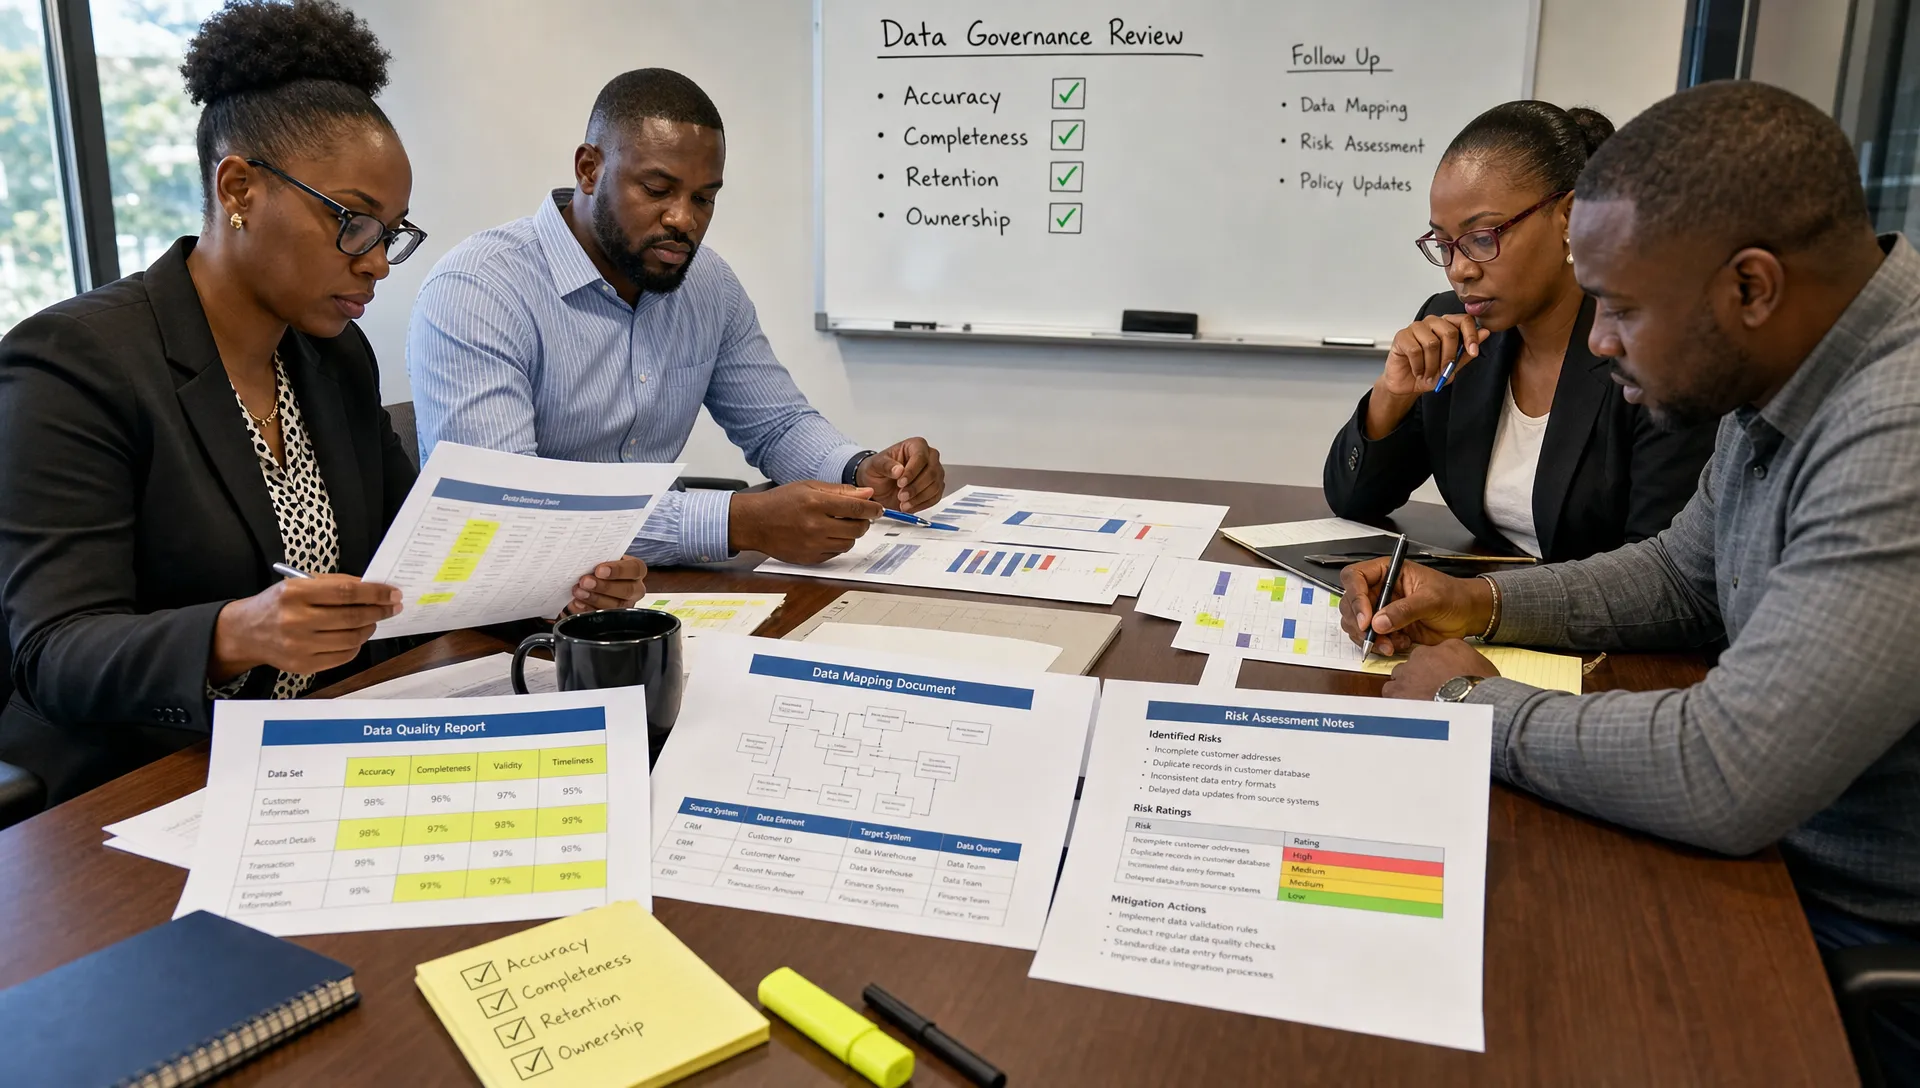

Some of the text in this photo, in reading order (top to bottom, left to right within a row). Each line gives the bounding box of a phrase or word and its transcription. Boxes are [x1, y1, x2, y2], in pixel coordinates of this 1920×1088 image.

[882, 19, 1184, 49] Data Governance Review
[1292, 44, 1381, 72] Follow Up
[904, 86, 1002, 113] Accuracy
[1301, 97, 1408, 121] Data Mapping
[904, 127, 1029, 153] Completeness
[1300, 135, 1426, 154] Risk Assessment
[906, 168, 999, 188] Retention
[1300, 174, 1412, 197] Policy Updates
[906, 208, 1011, 235] Ownership
[813, 667, 956, 696] Data Mapping Document
[1225, 711, 1355, 729] Risk Assessment Notes
[363, 721, 486, 738] Data Quality Report
[1149, 730, 1222, 743] Identified Risks
[1155, 746, 1281, 762] Incomplete customer addresses
[358, 757, 594, 776] Accuracy Completeness Validity Timeliness
[1153, 759, 1190, 769] Duplicate
[1192, 763, 1222, 771] records
[1234, 767, 1272, 775] customer
[1274, 769, 1310, 779] database
[1151, 772, 1276, 789] Inconsistent data entry formats
[262, 797, 301, 805] Customer
[364, 787, 583, 806] 98% 96% 97% 95%
[1149, 786, 1320, 807] Delayed data updates from source systems
[260, 808, 309, 817] Information
[690, 804, 739, 817] Source System
[757, 813, 774, 822] Data
[1133, 803, 1192, 818] Risk Ratings
[427, 824, 448, 833] 97%
[684, 822, 702, 830] CRM
[861, 828, 884, 839] Target
[255, 838, 287, 846] Account
[748, 832, 782, 842] Customer
[1294, 838, 1320, 848] Rating
[741, 848, 801, 863] Customer Name
[854, 847, 916, 861] Data Warehouse
[957, 841, 1001, 854] Data Owner
[947, 860, 965, 868] Data
[1165, 852, 1192, 860] records
[1202, 855, 1235, 864] customer
[1237, 858, 1270, 867] database
[733, 864, 764, 874] Account
[850, 863, 913, 878] Data Warehouse
[1206, 869, 1235, 877] formats
[1291, 866, 1325, 876] Medium
[844, 879, 904, 894] Finance System
[943, 876, 982, 887] Data Team
[1289, 880, 1324, 889] Medium
[970, 896, 990, 904] Team
[1111, 895, 1207, 914] Mitigation Actions
[1119, 912, 1258, 934] Implement data validation rules
[1117, 925, 1276, 951] Conduct regular data quality checks
[506, 938, 589, 973] Accuracy
[1114, 938, 1253, 962] Standardize data entry formats
[1111, 952, 1274, 979] Improve data integration processes
[522, 953, 631, 1000] Completeness
[540, 992, 621, 1029] Retention
[558, 1019, 644, 1060] Ownership
